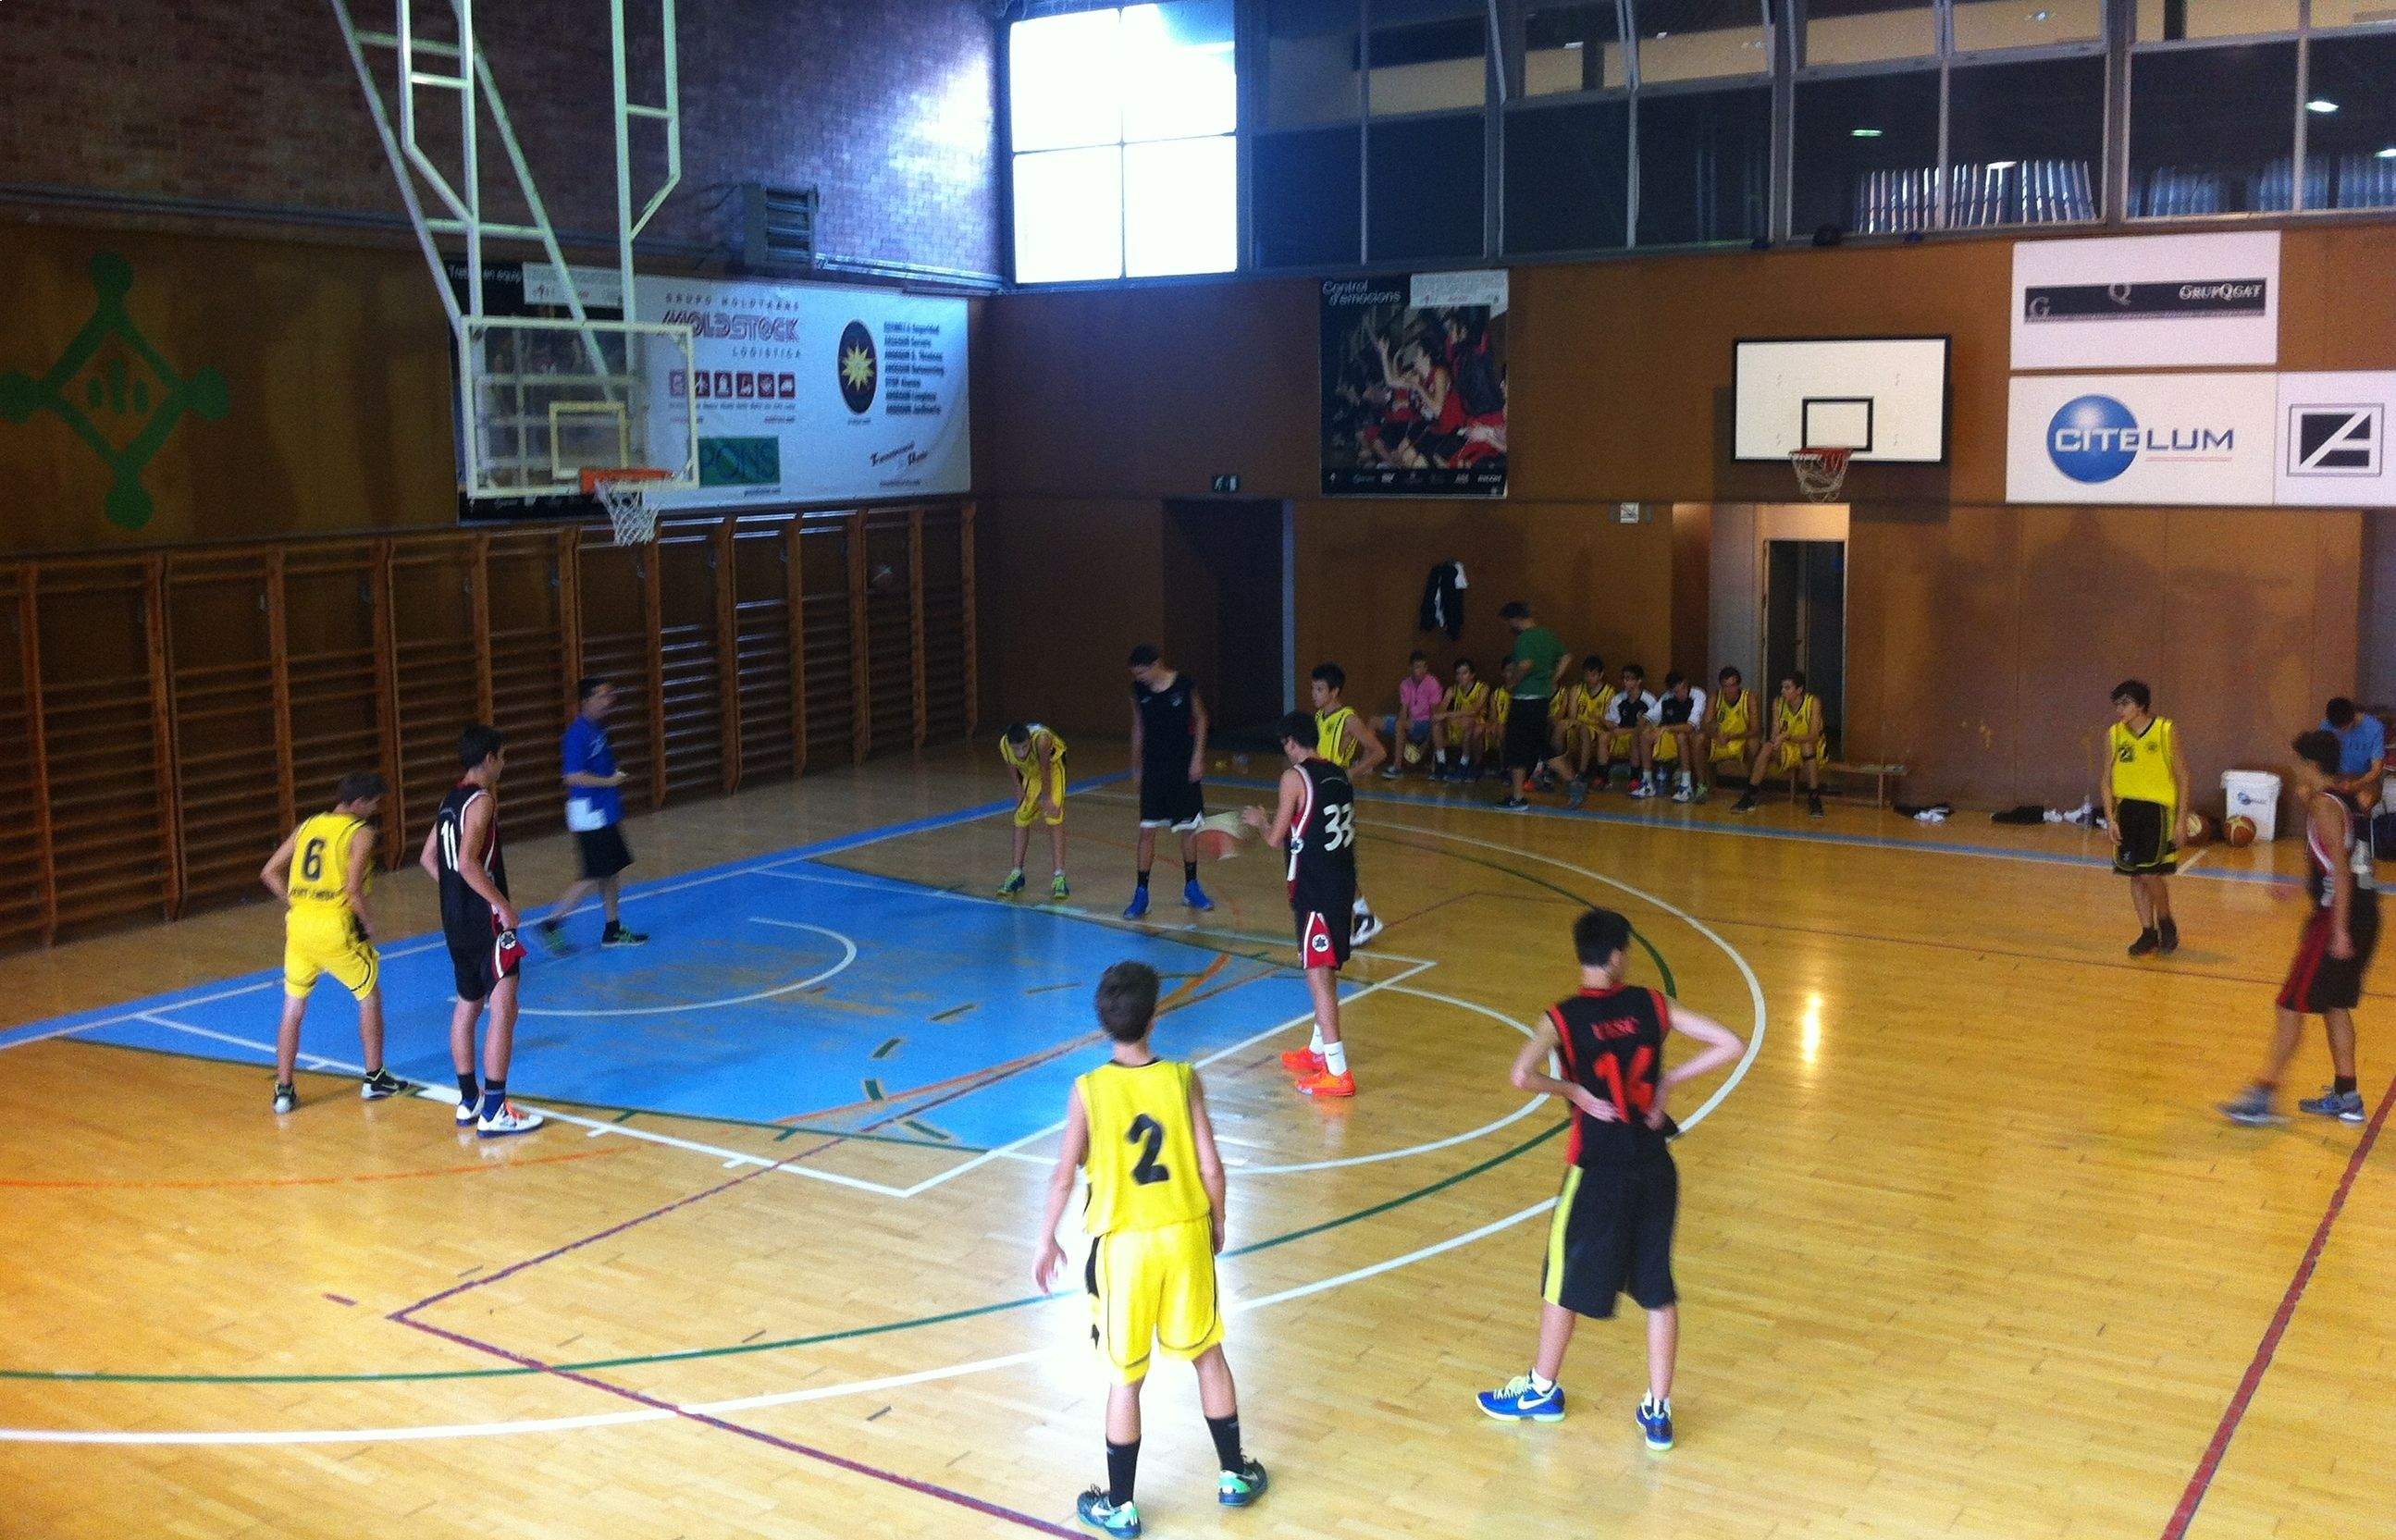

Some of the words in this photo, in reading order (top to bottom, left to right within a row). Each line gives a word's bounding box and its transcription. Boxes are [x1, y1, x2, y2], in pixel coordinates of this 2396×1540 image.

[2054, 426, 2235, 453] CITELUM
[440, 819, 459, 872] 11
[1323, 802, 1355, 852] 33
[302, 836, 326, 881] 6
[1127, 1113, 1170, 1186] 2
